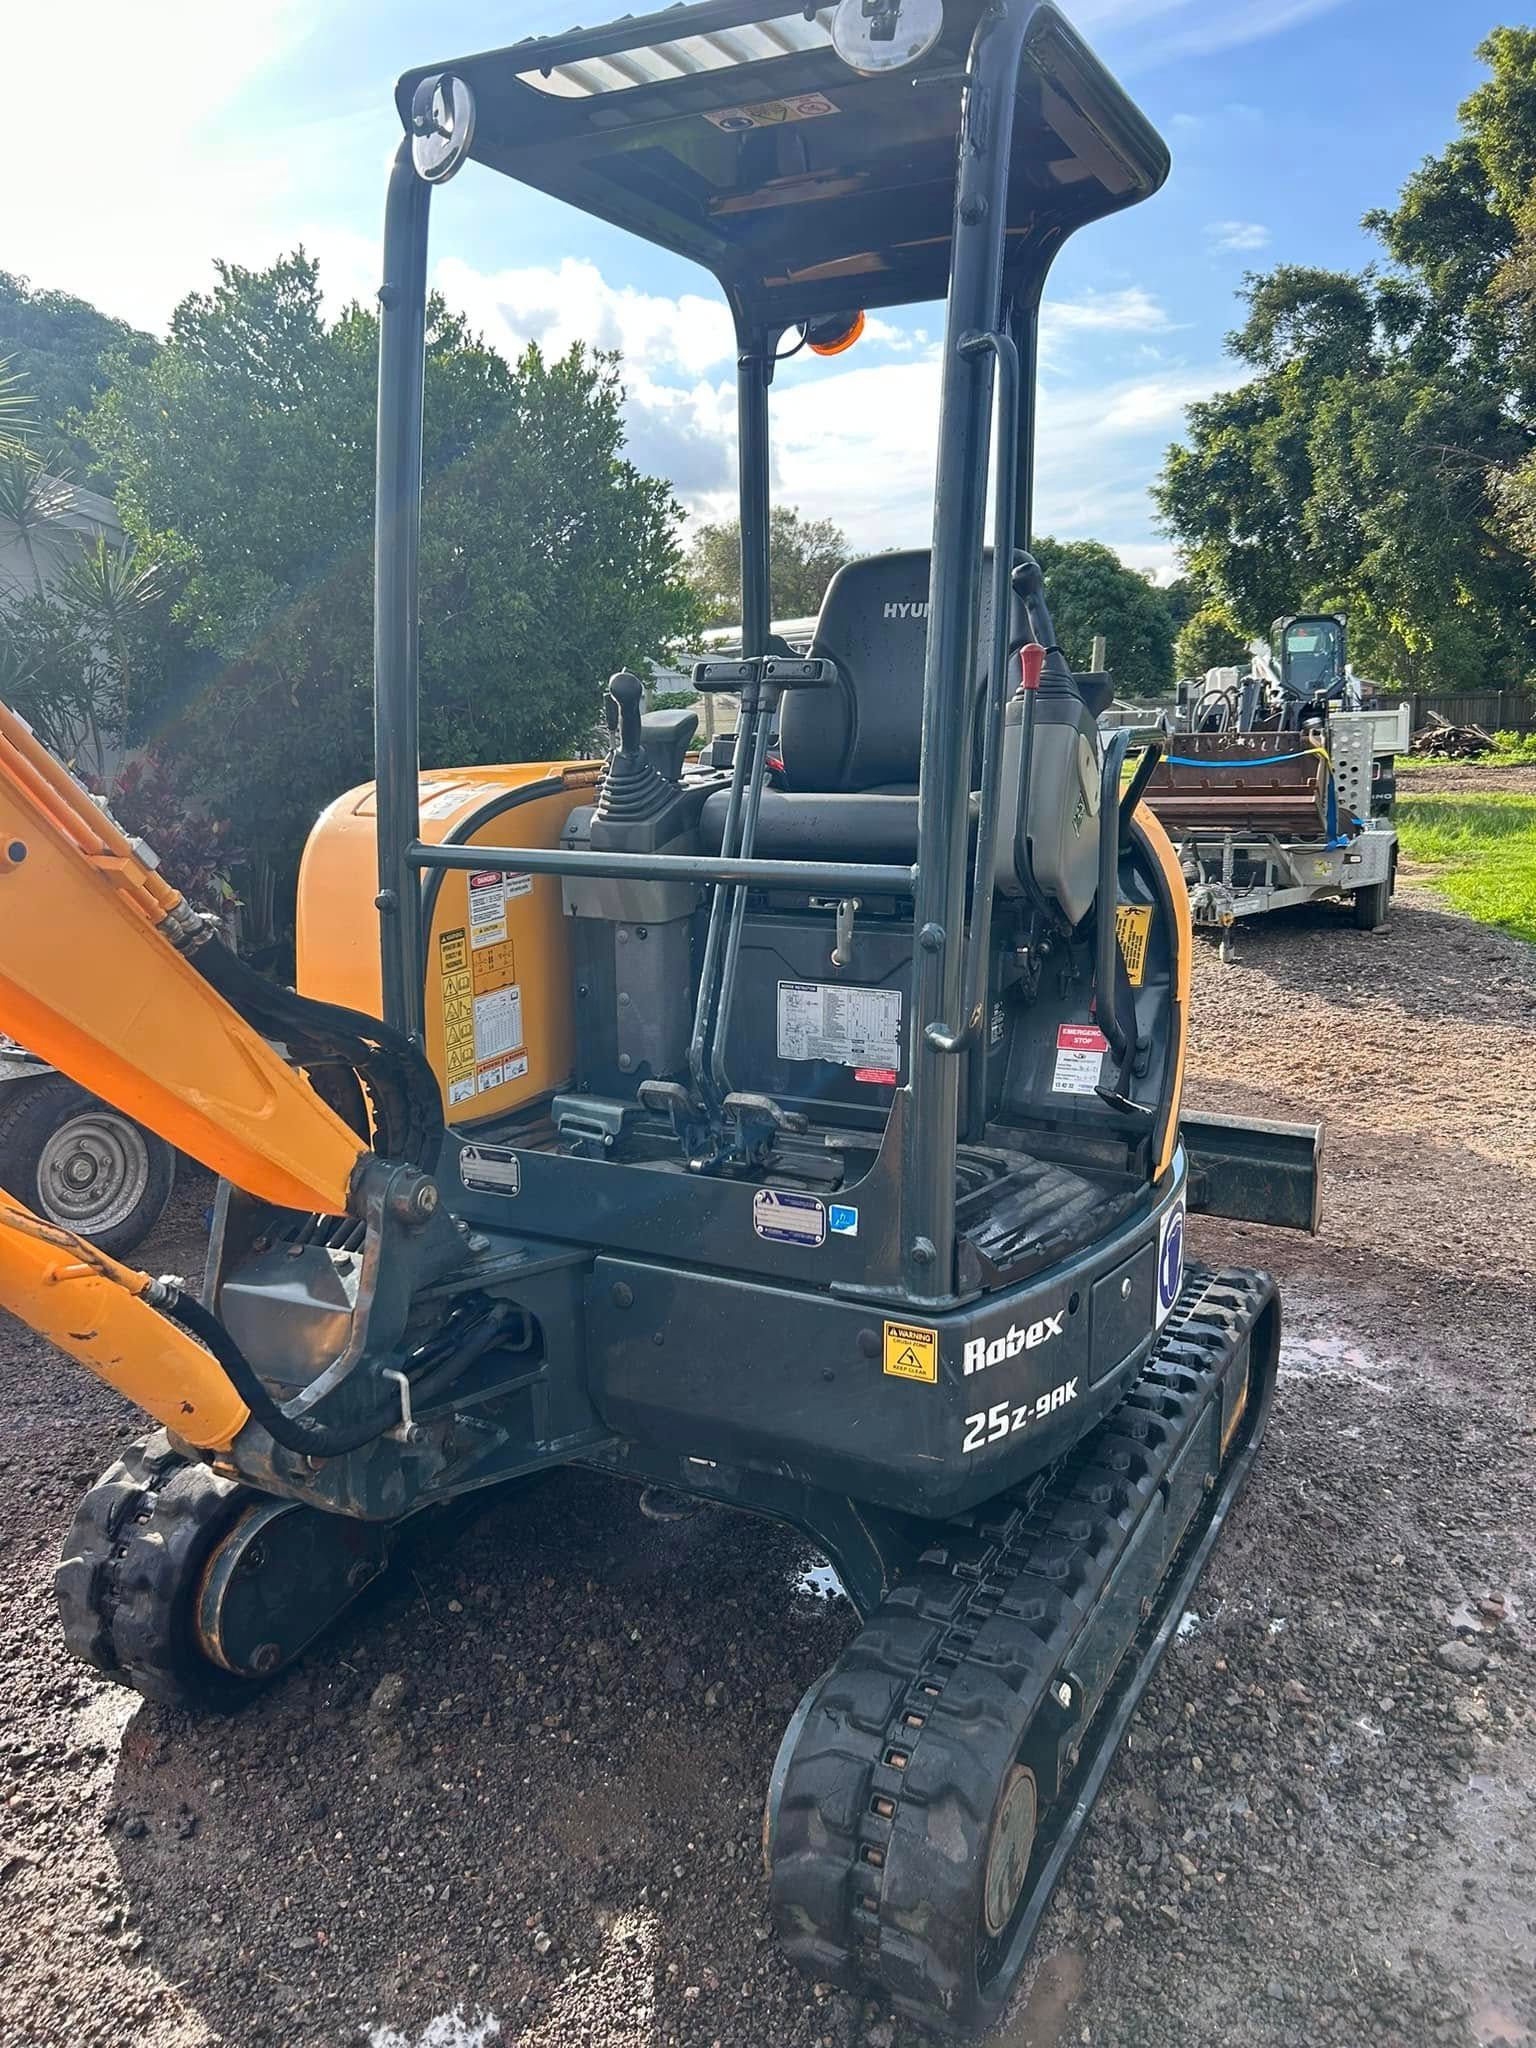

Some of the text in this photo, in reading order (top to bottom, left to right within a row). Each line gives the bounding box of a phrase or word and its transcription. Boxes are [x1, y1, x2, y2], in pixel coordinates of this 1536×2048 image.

[1062, 1028, 1102, 1036] EMERGENC
[899, 1330, 931, 1343] WARNING
[963, 1309, 1064, 1376] Robex
[893, 1337, 927, 1349] CRUSH ZONE
[908, 1368, 927, 1376] CLEAR
